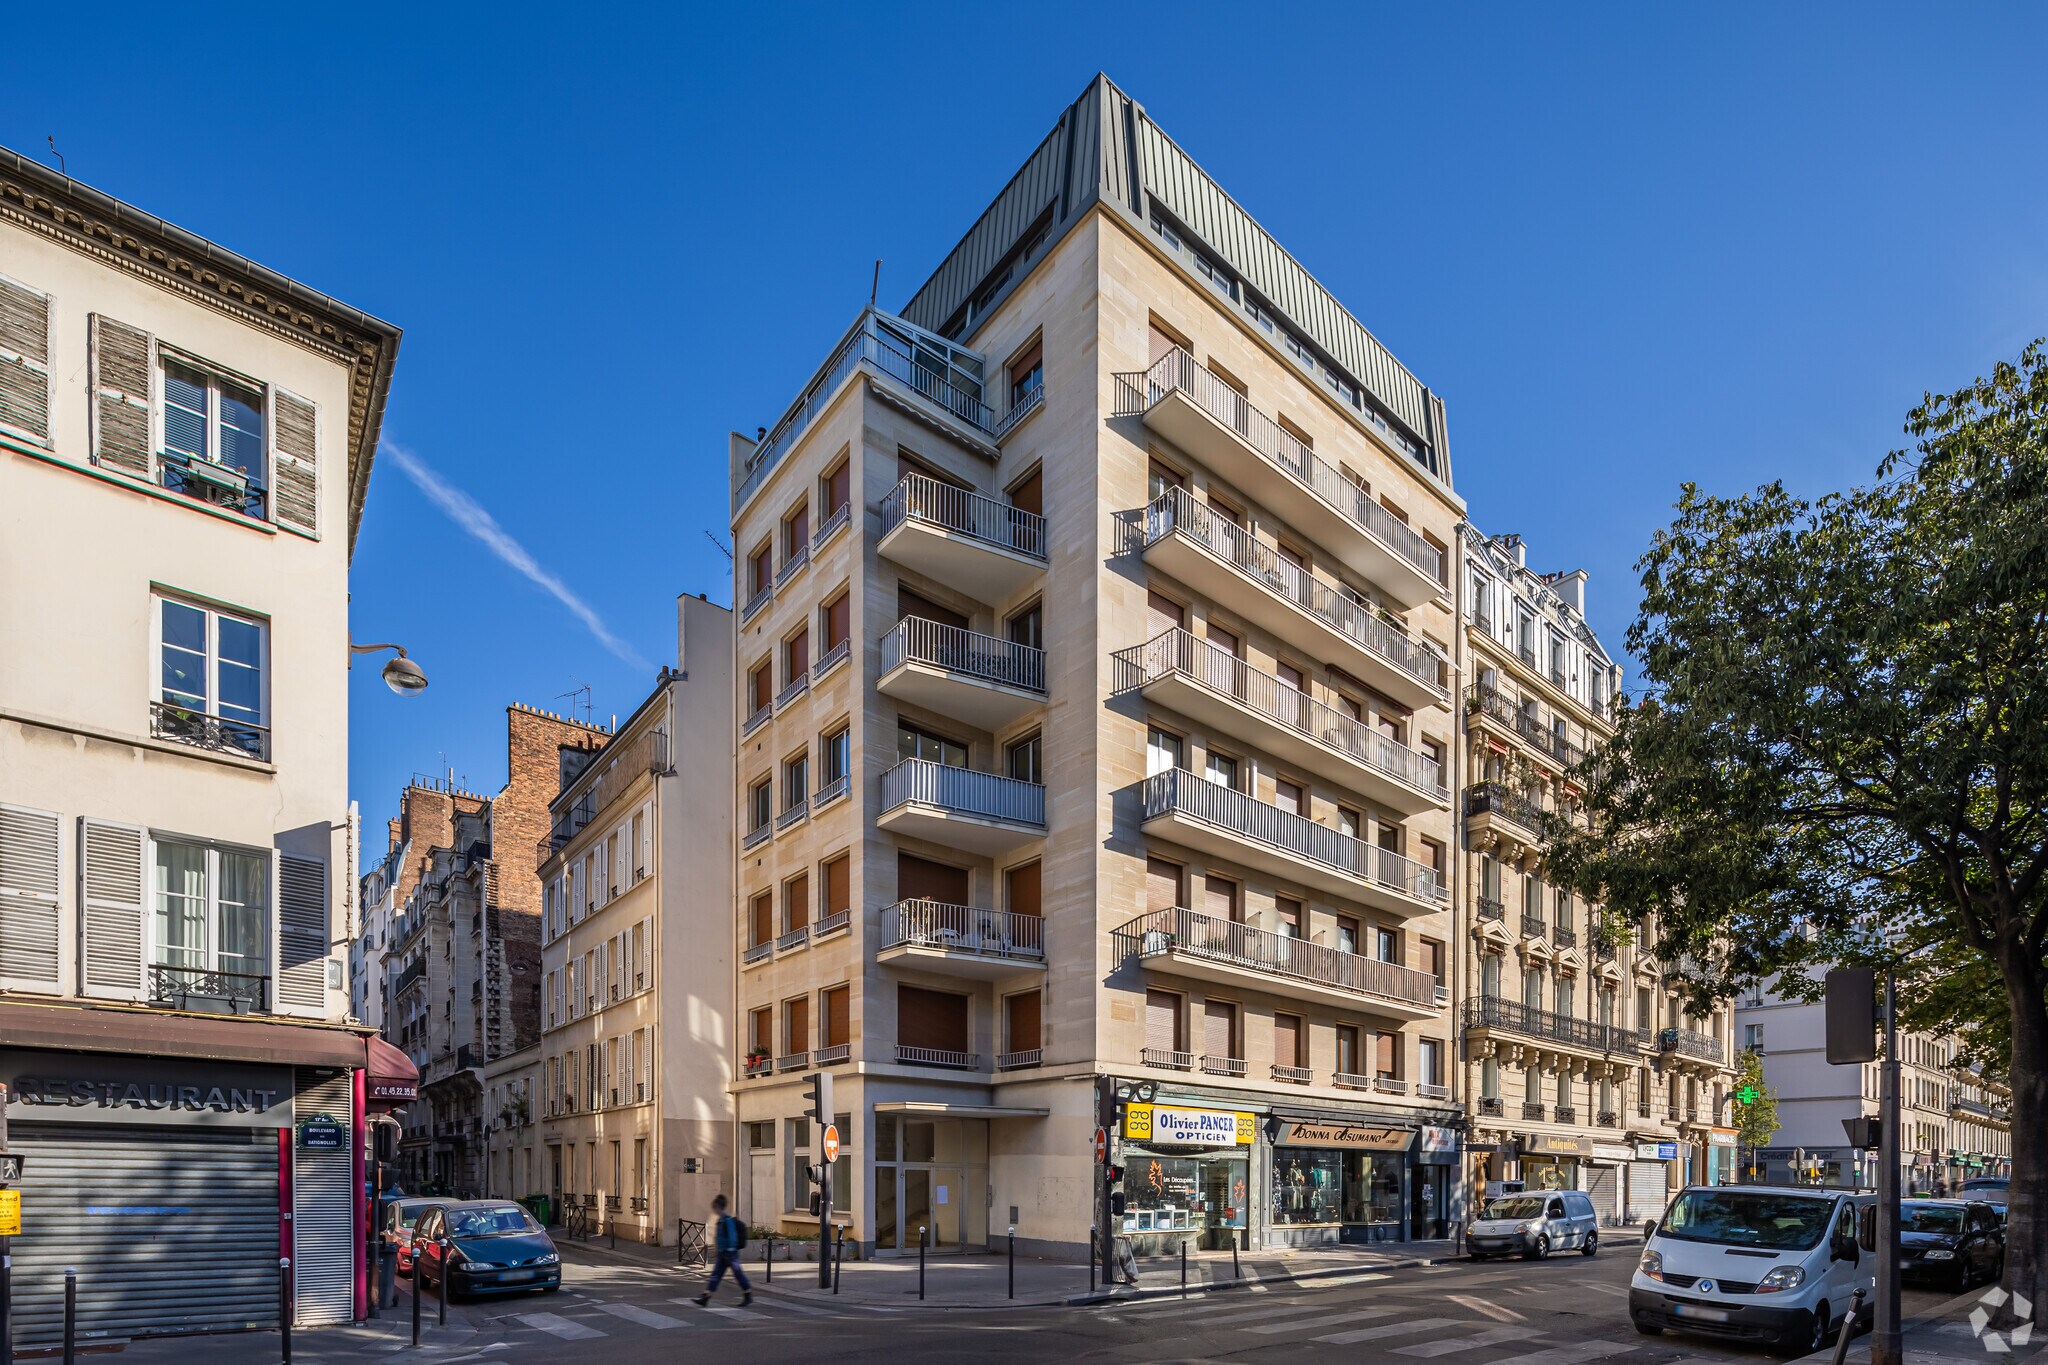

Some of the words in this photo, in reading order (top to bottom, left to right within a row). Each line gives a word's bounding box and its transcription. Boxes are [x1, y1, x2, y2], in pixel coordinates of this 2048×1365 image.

[12, 1077, 277, 1112] RESTAURANT
[1160, 1113, 1199, 1129] Olivier
[1200, 1115, 1234, 1132] PANCER
[1297, 1128, 1330, 1140] DONNA
[1712, 1132, 1735, 1144] PHARMACIE
[1546, 1136, 1579, 1152] Antiquités
[1760, 1151, 1788, 1161] Crédit
